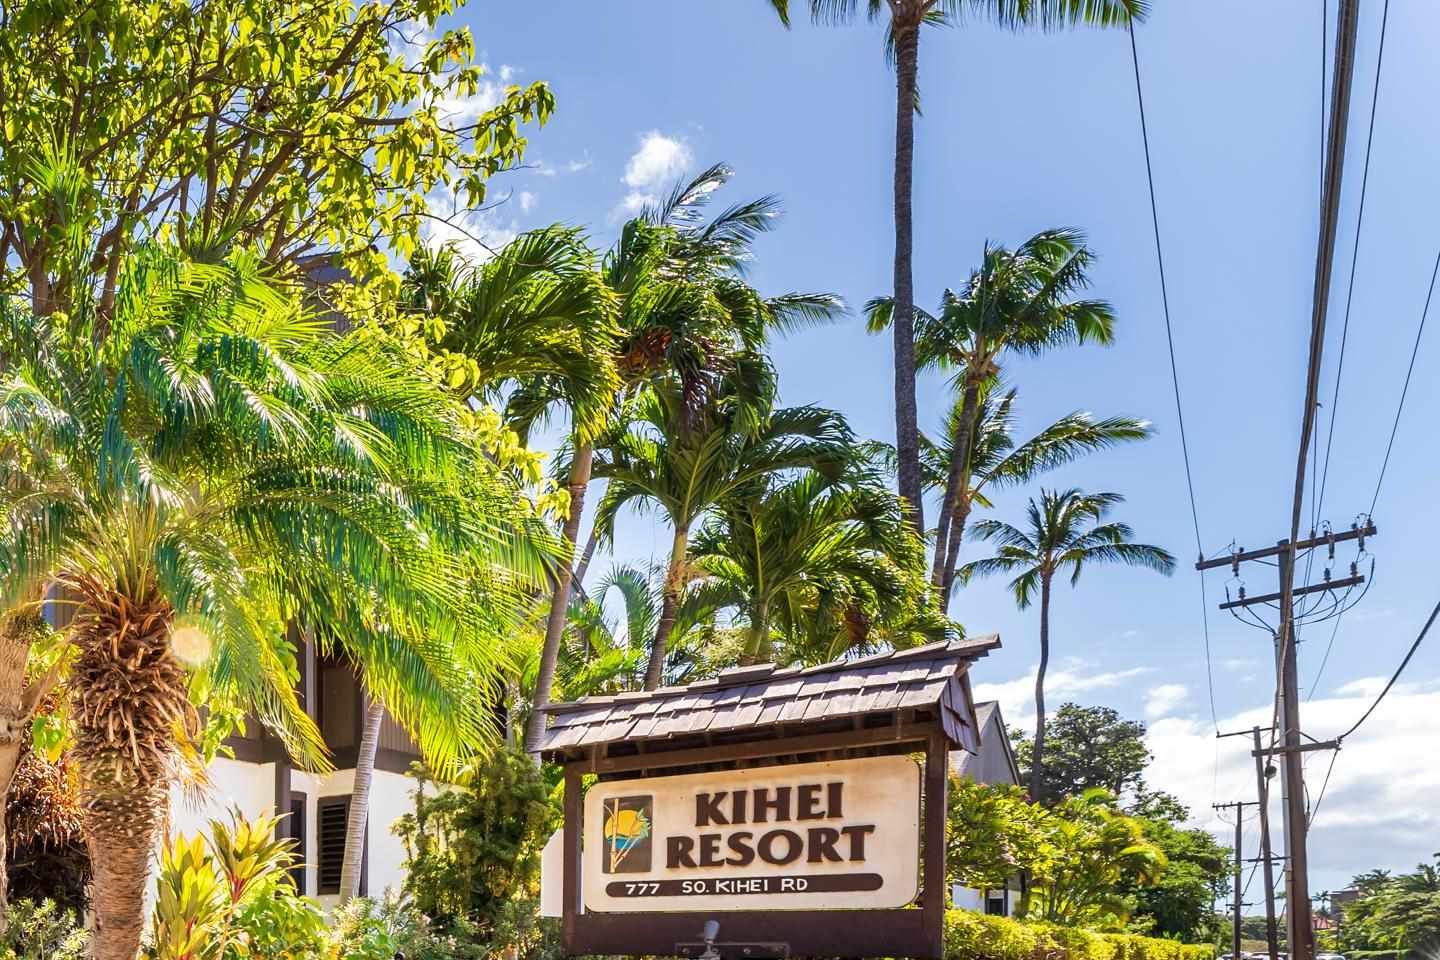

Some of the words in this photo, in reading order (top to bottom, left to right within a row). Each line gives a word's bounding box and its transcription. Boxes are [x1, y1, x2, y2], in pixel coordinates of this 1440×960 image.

[694, 782, 845, 827] KIHEI
[665, 824, 876, 869] RESORT
[625, 882, 660, 895] 777
[682, 880, 710, 894] SO.
[715, 879, 769, 894] KIHEI
[781, 878, 808, 892] RD
